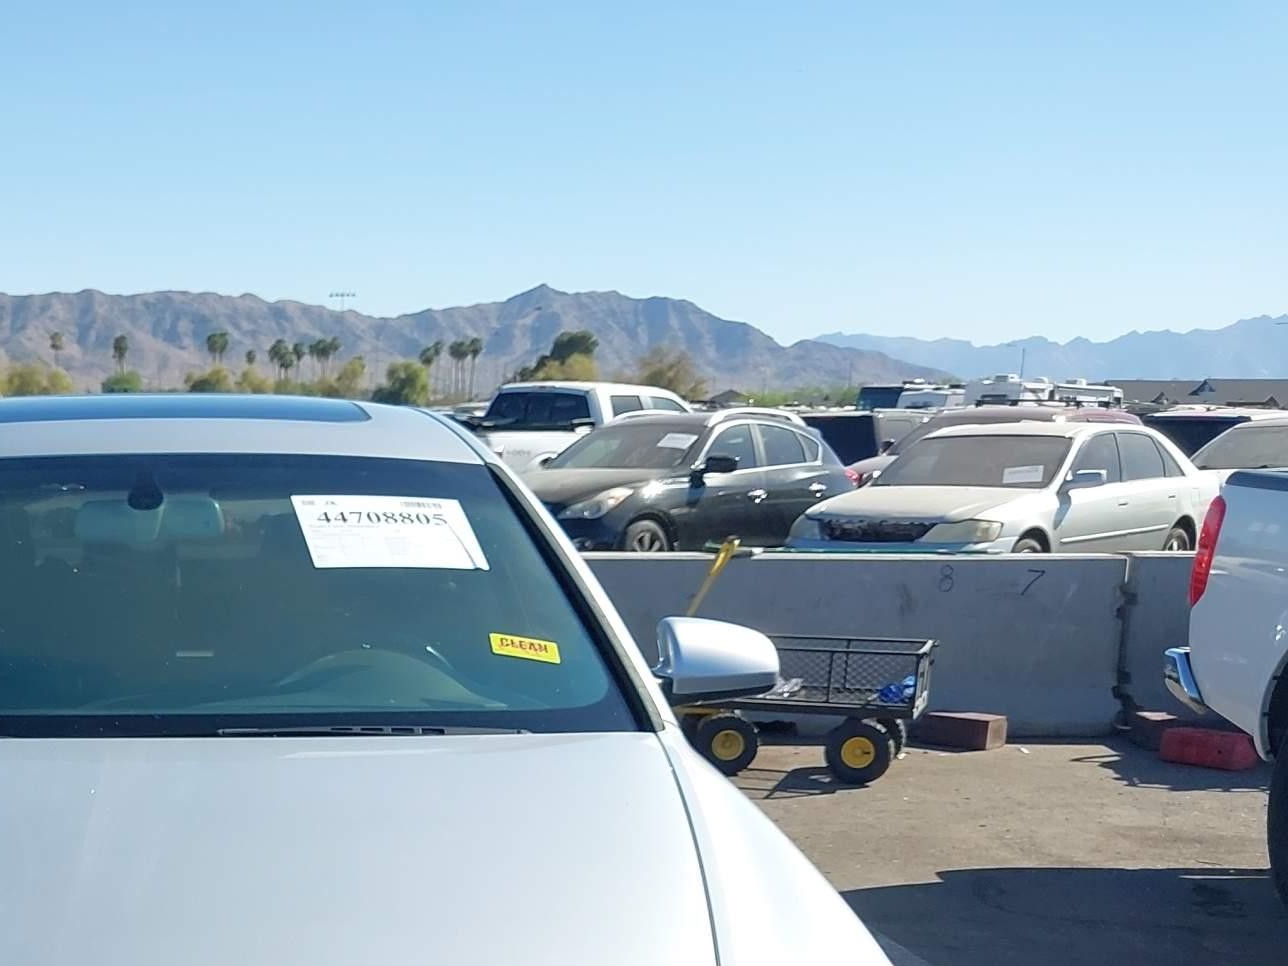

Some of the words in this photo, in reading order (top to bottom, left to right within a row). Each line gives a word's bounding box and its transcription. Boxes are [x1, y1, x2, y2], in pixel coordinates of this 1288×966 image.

[316, 511, 448, 526] 44708805
[938, 564, 954, 593] 8
[1019, 569, 1046, 596] 7
[499, 637, 549, 654] CLEAN
